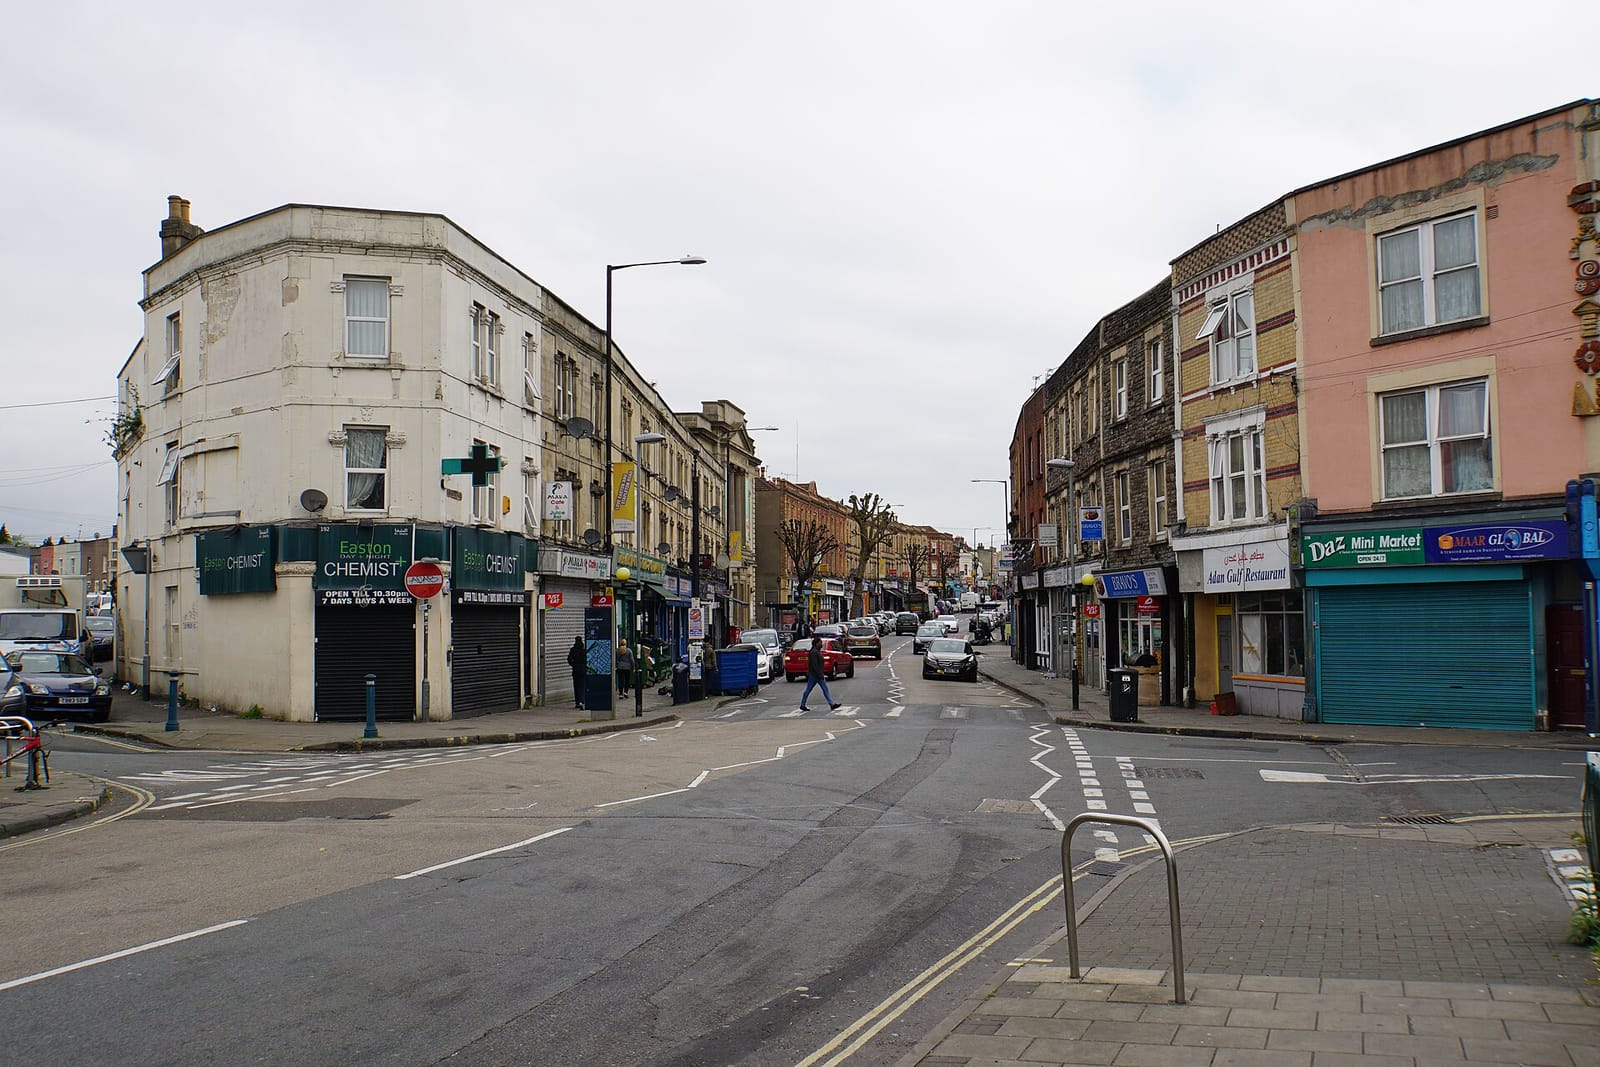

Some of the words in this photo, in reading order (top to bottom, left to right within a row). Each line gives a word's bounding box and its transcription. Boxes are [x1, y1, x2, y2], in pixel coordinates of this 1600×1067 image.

[340, 541, 392, 554] Easton
[1308, 536, 1346, 562] Daz
[1351, 536, 1374, 550] Mini
[1380, 533, 1421, 548] Market
[204, 557, 226, 568] Easton
[227, 554, 262, 570] CHEMIST
[324, 562, 400, 576] CHEMIST
[486, 554, 517, 574] CHEMIST
[1207, 570, 1225, 584] Adan
[1226, 568, 1244, 586] Gulf
[1246, 568, 1286, 582] Restaurant
